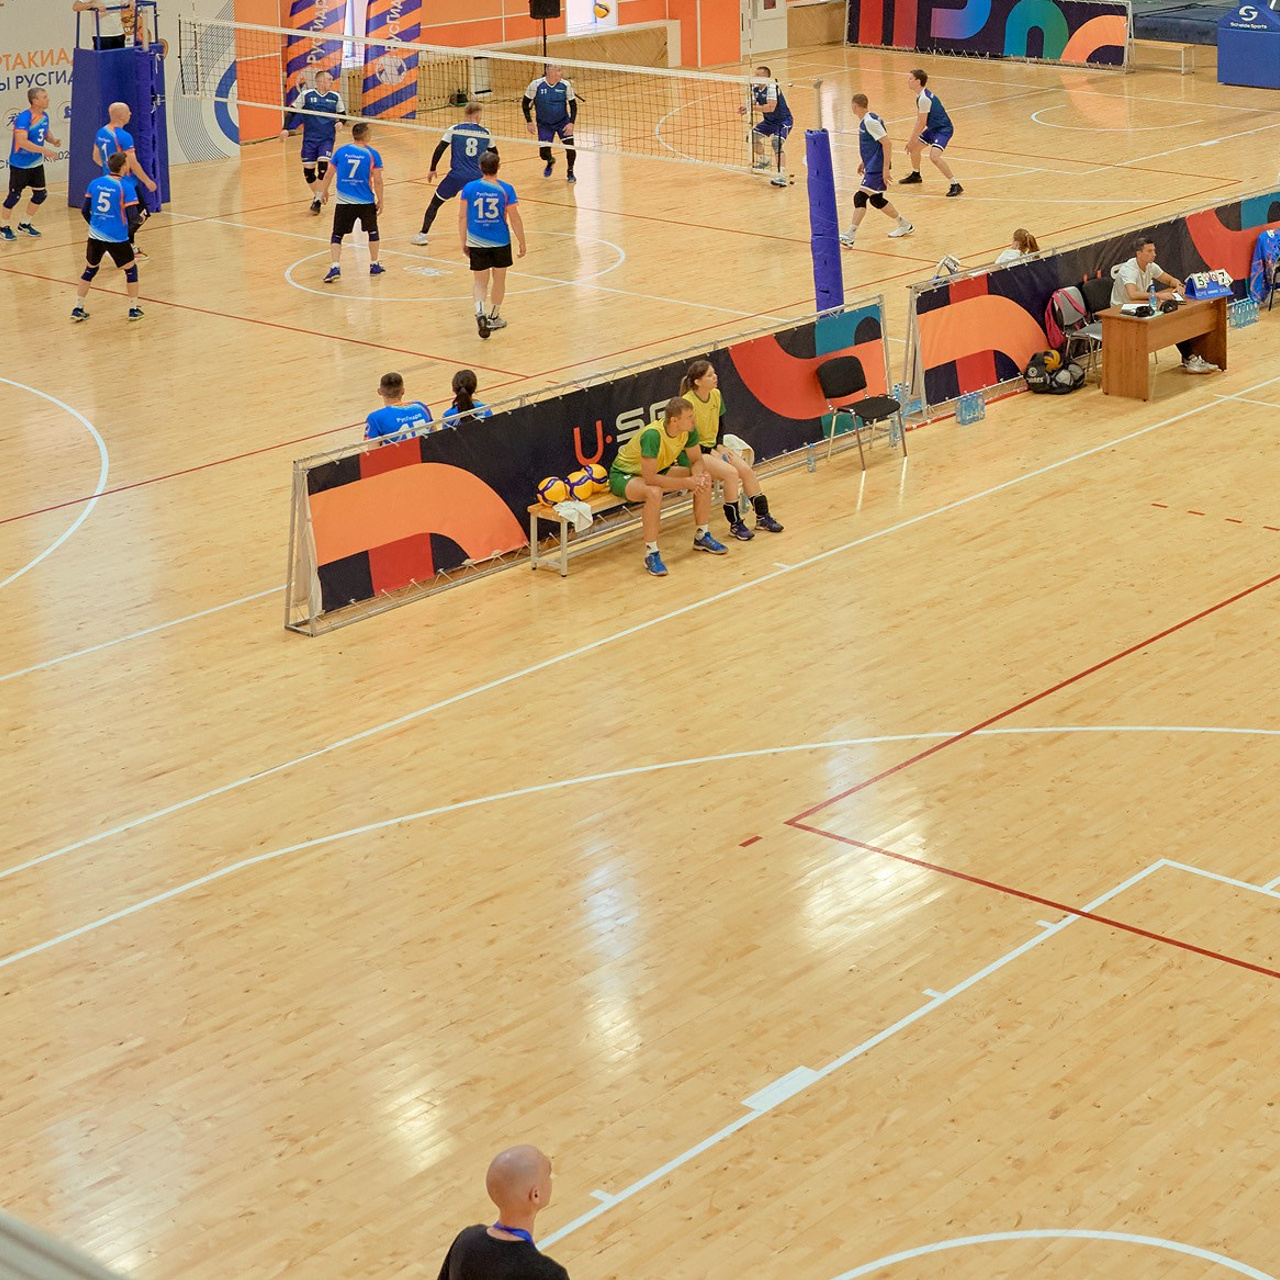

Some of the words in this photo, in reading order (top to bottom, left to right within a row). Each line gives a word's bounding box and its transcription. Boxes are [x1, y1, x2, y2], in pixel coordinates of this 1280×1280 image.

[0, 47, 73, 71] ТАКИА
[38, 128, 45, 142] 3
[465, 137, 478, 157] 8
[347, 159, 360, 178] 7
[97, 191, 111, 212] 5
[474, 197, 499, 218] 13
[1197, 275, 1204, 285] 5
[1219, 272, 1225, 282] 7
